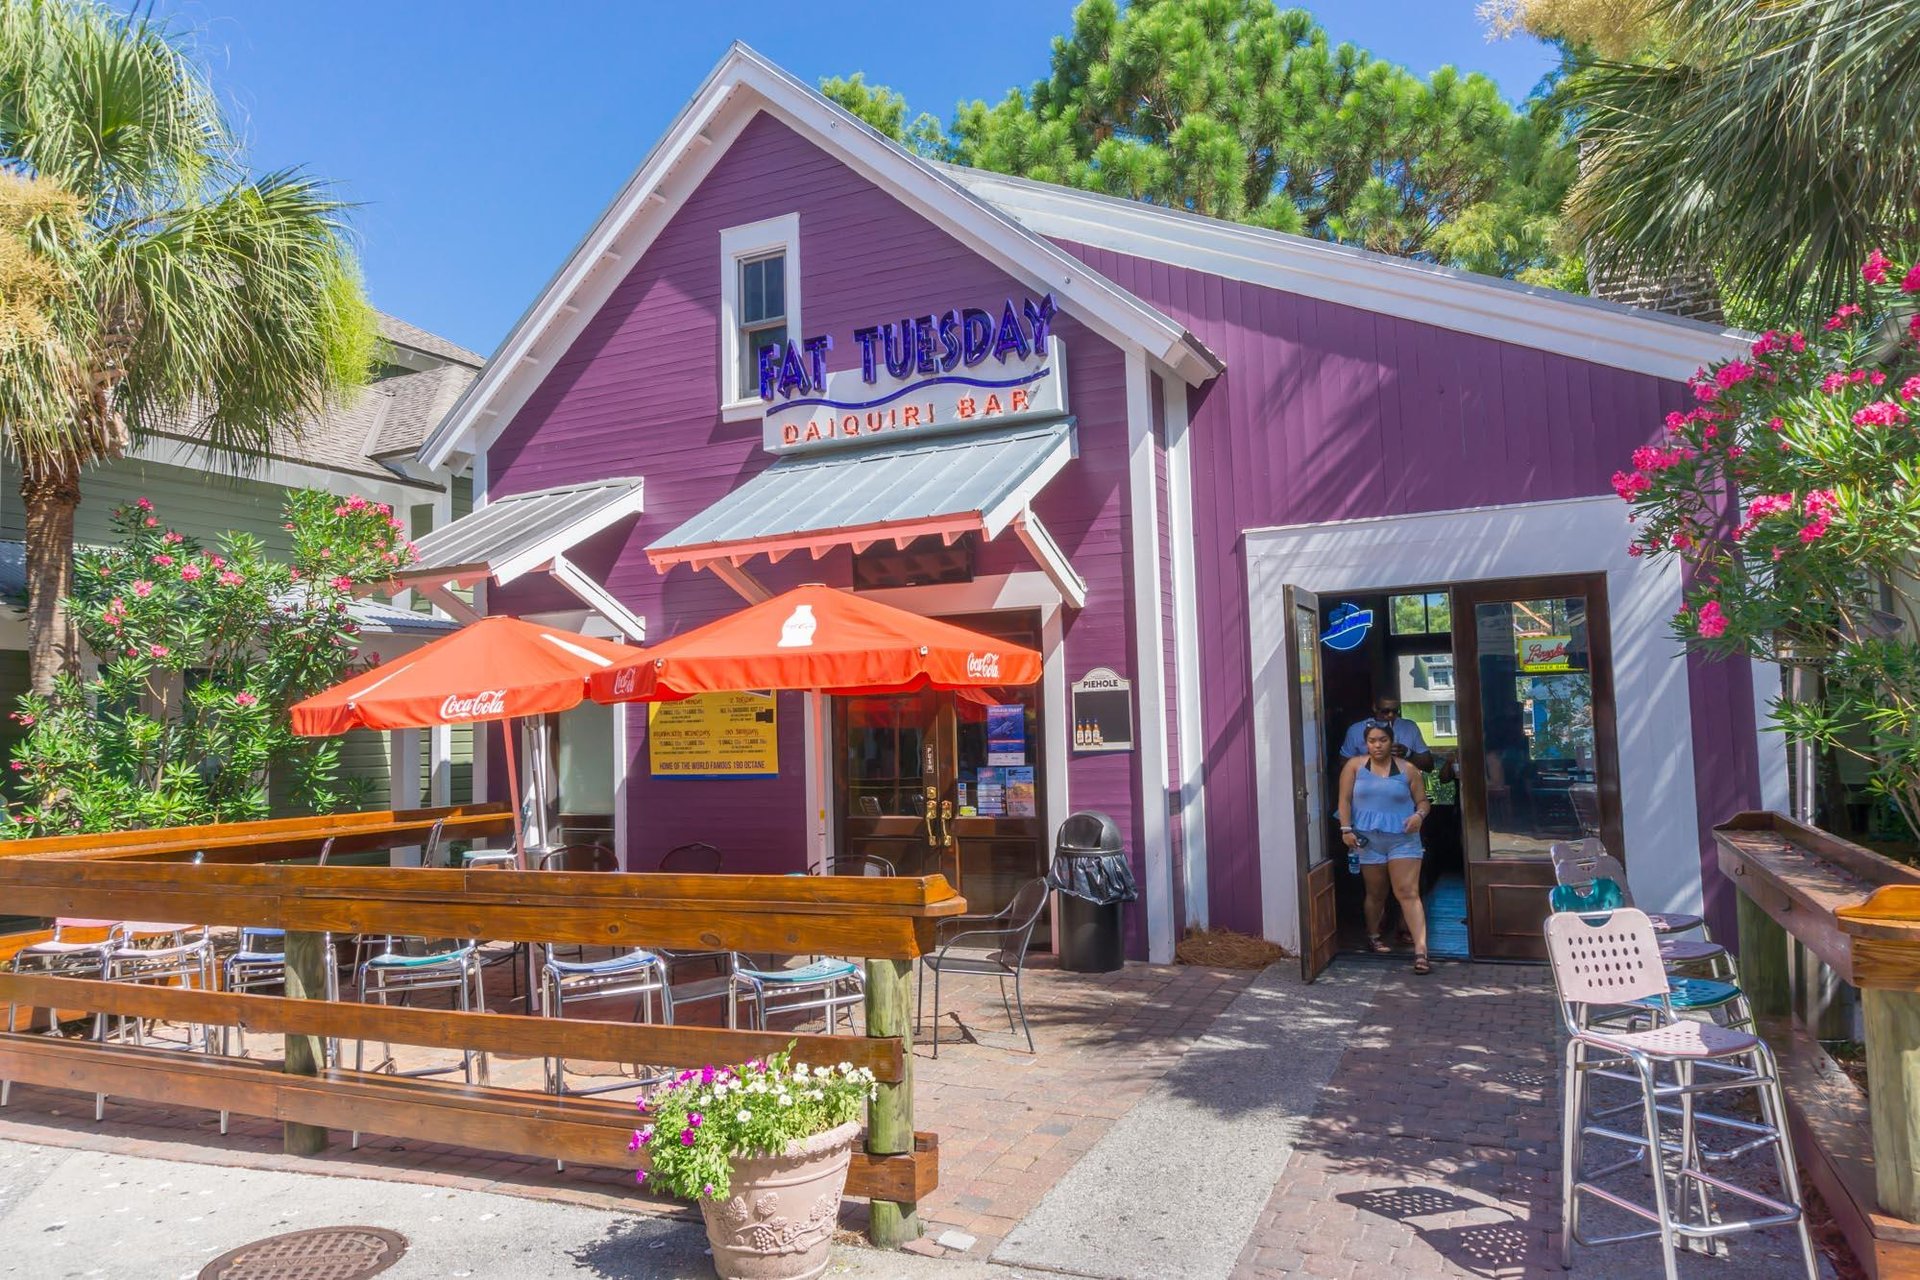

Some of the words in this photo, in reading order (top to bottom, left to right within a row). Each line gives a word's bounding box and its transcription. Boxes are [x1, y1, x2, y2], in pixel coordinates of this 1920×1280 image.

[758, 335, 833, 400] FAT
[854, 293, 1058, 385] TUESDAY
[783, 403, 935, 444] DAIQUIRI
[958, 389, 1030, 419] BAR
[1083, 680, 1119, 689] PIEHOLE
[440, 689, 507, 720] Coca-Cola
[659, 761, 674, 770] HOME
[673, 761, 680, 769] OF
[681, 761, 692, 769] THE
[691, 761, 710, 769] WORLD
[710, 761, 732, 769] FAMOUS
[744, 760, 765, 769] OCTANE
